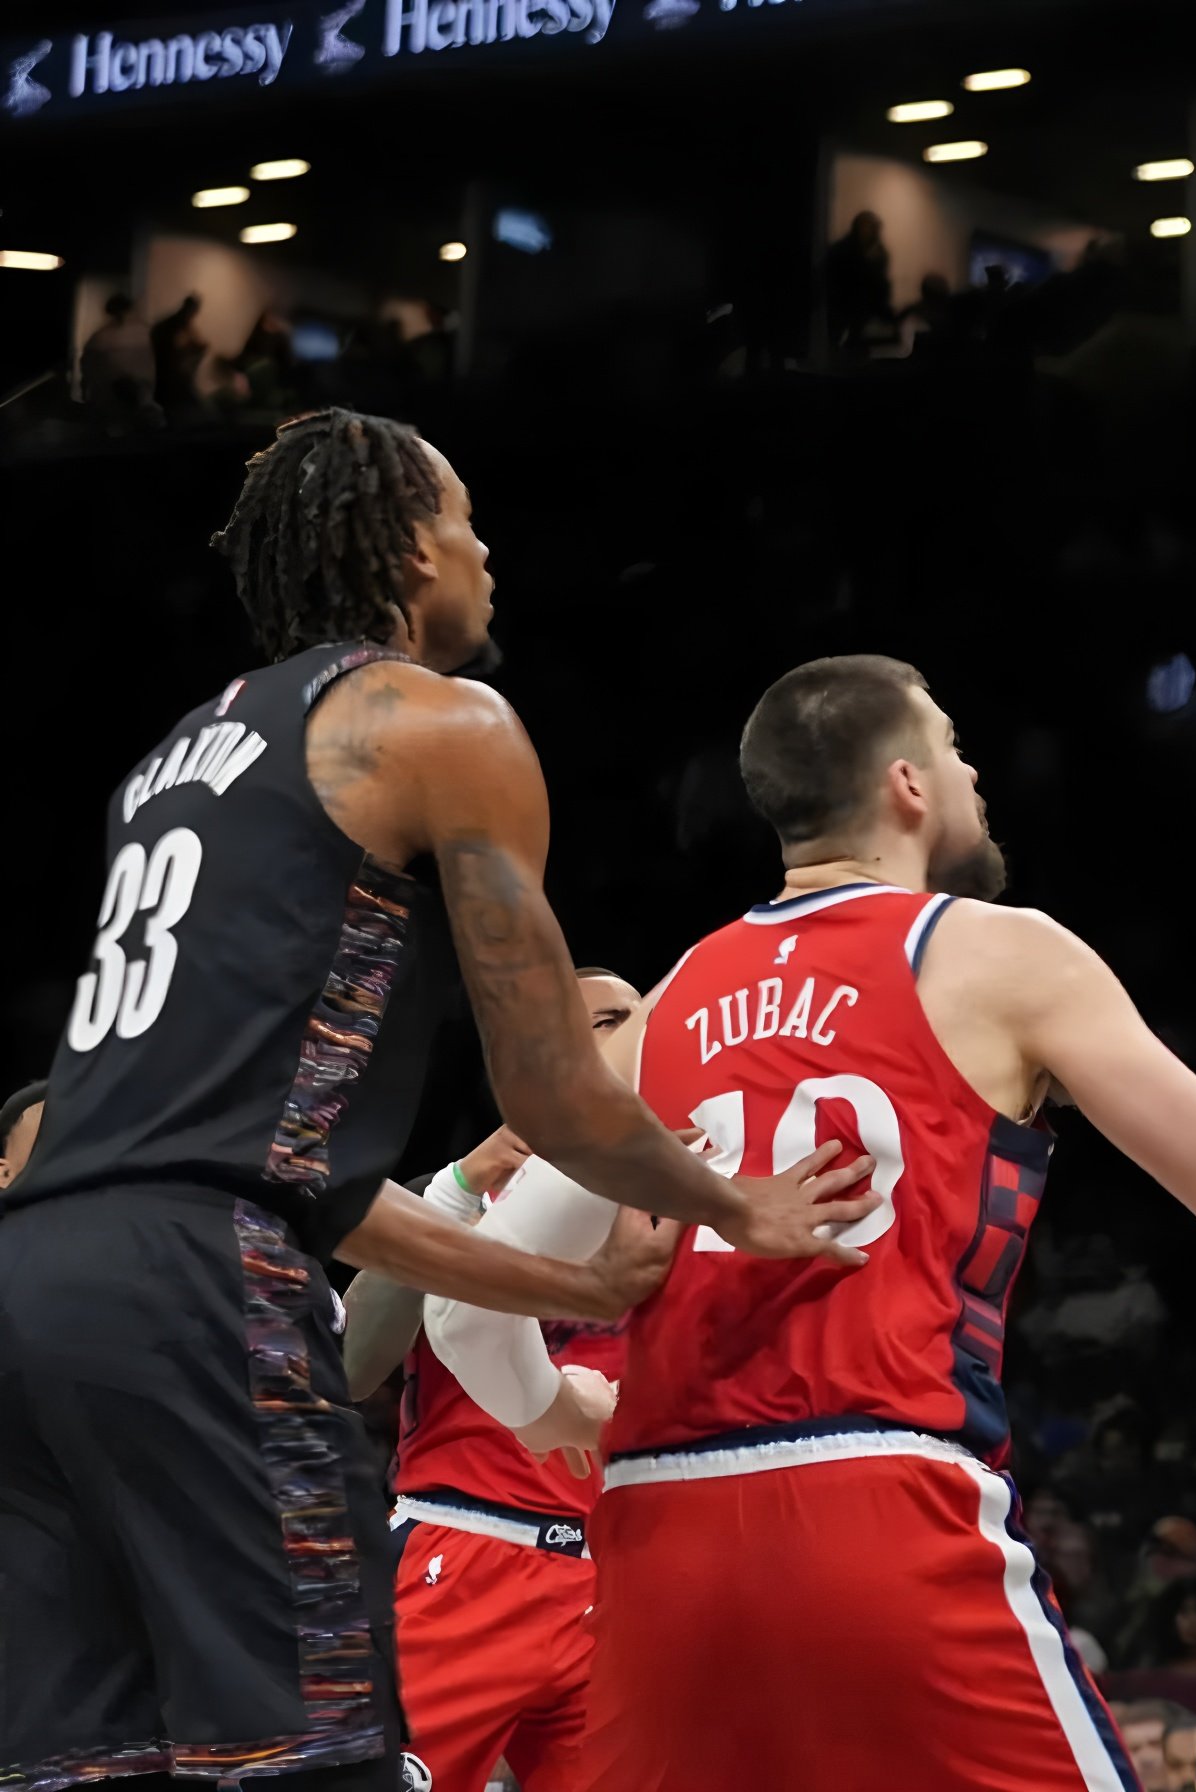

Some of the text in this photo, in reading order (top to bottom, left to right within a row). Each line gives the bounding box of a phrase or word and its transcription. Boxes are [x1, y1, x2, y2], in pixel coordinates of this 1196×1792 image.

[69, 21, 293, 98] Hennessy
[67, 827, 202, 1052] 33
[684, 977, 859, 1065] ZUBAC
